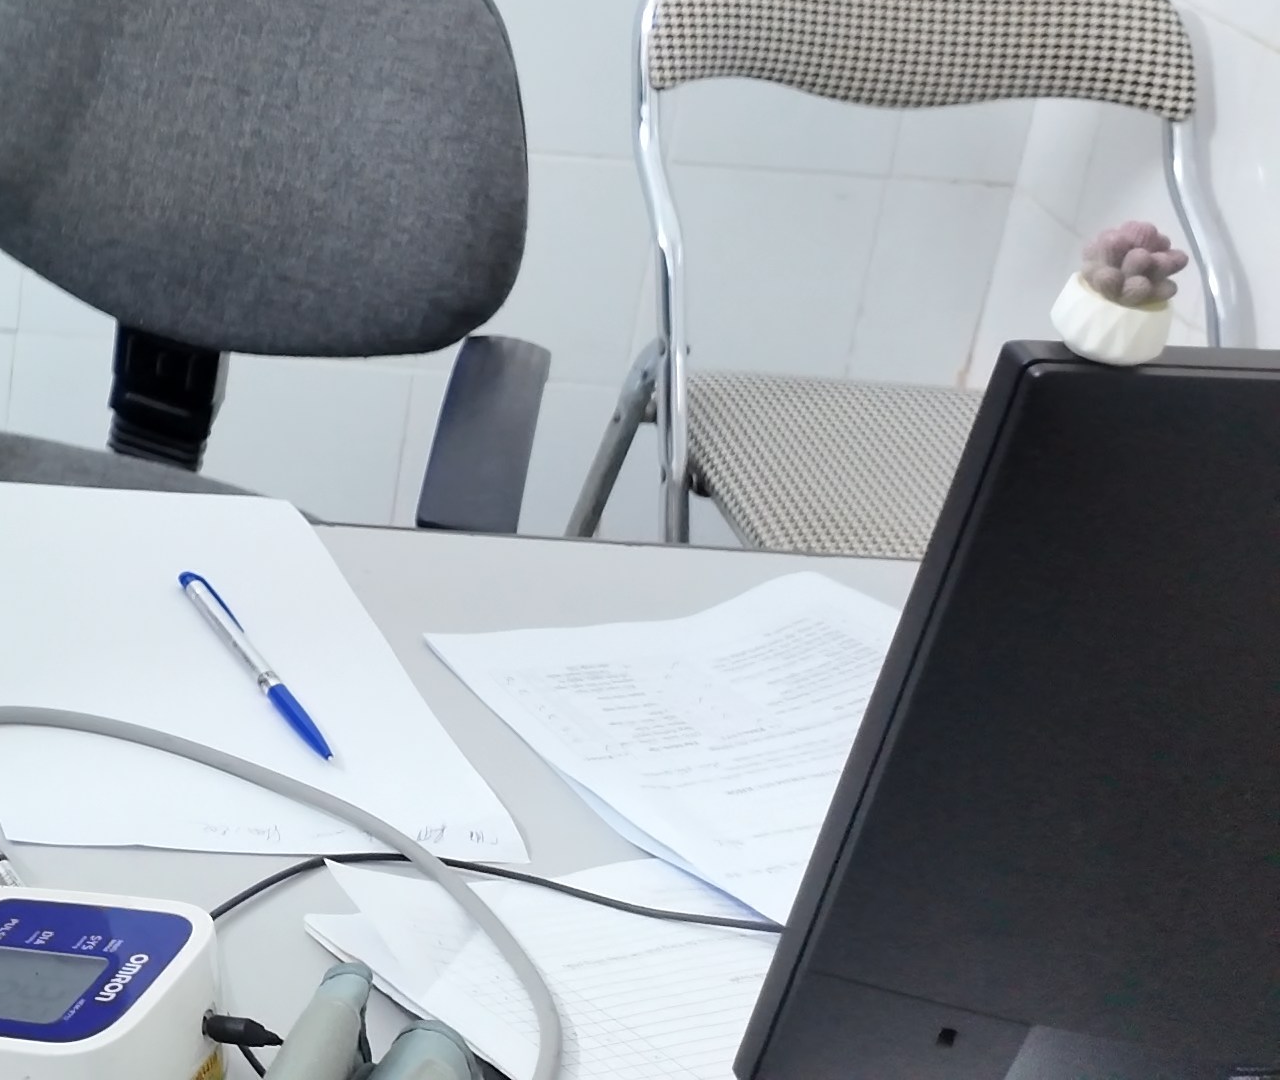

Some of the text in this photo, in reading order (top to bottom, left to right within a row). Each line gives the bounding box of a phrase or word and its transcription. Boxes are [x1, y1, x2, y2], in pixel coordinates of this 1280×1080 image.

[33, 930, 55, 945] DIA
[81, 935, 103, 950] SYS
[94, 953, 149, 1002] OMRON
